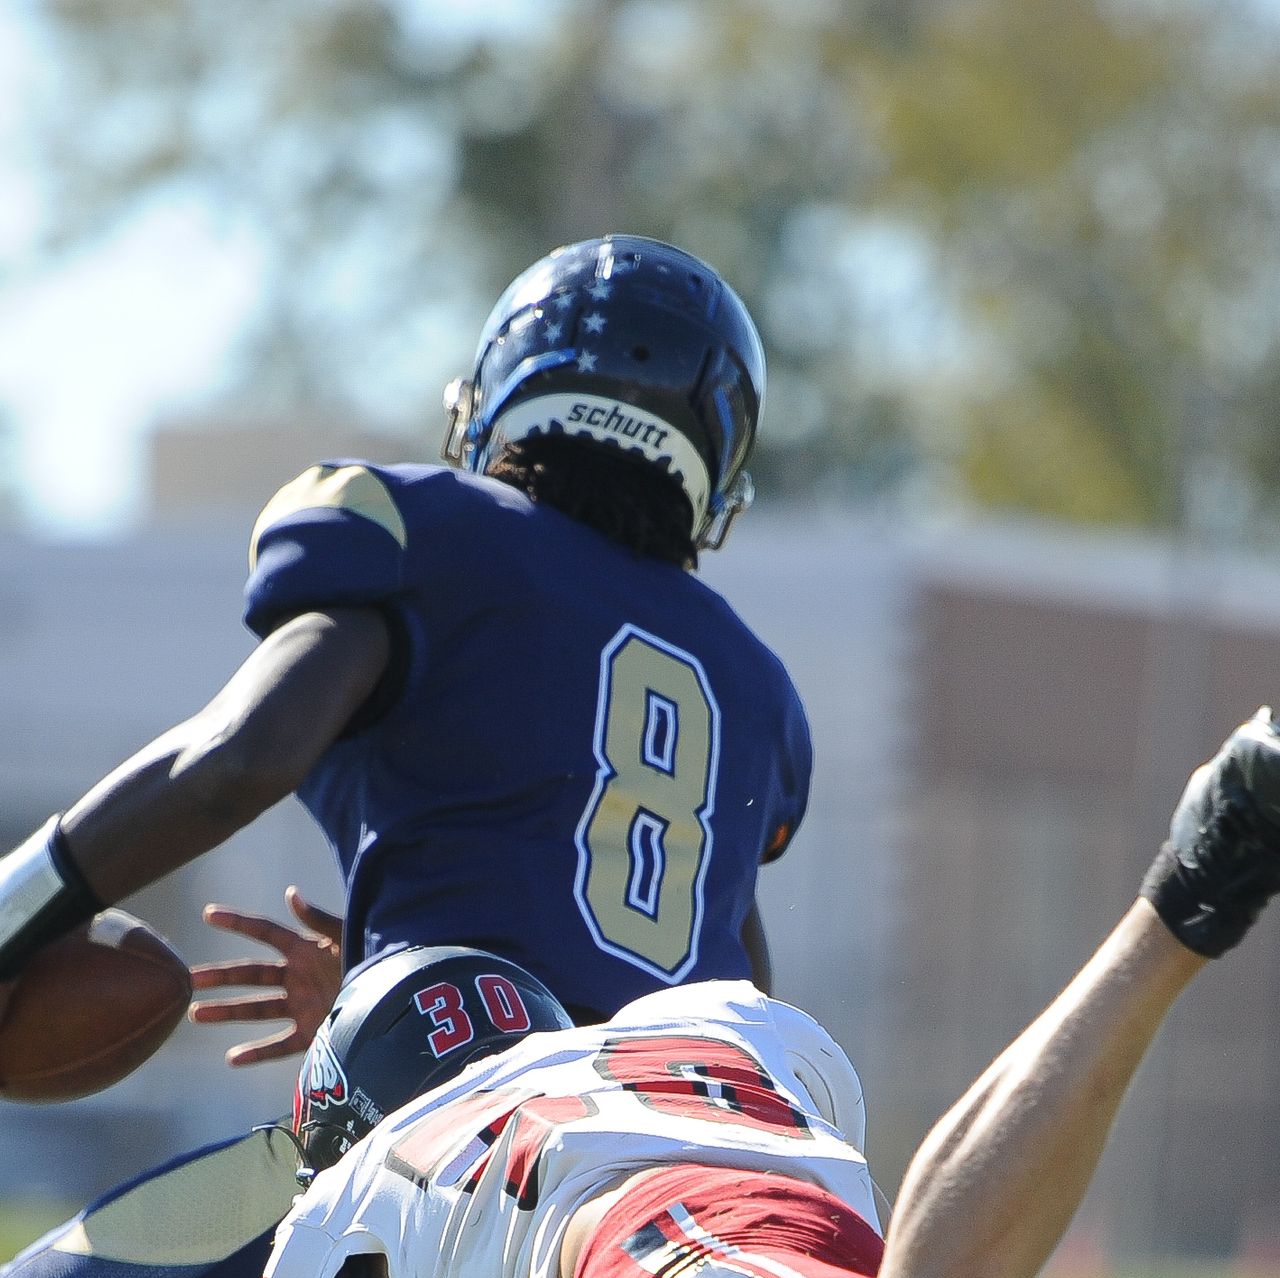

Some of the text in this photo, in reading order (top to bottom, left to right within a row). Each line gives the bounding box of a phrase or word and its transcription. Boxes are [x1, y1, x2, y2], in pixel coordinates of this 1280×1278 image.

[567, 404, 668, 448] schutt
[573, 622, 720, 985] 8
[413, 974, 531, 1059] 30
